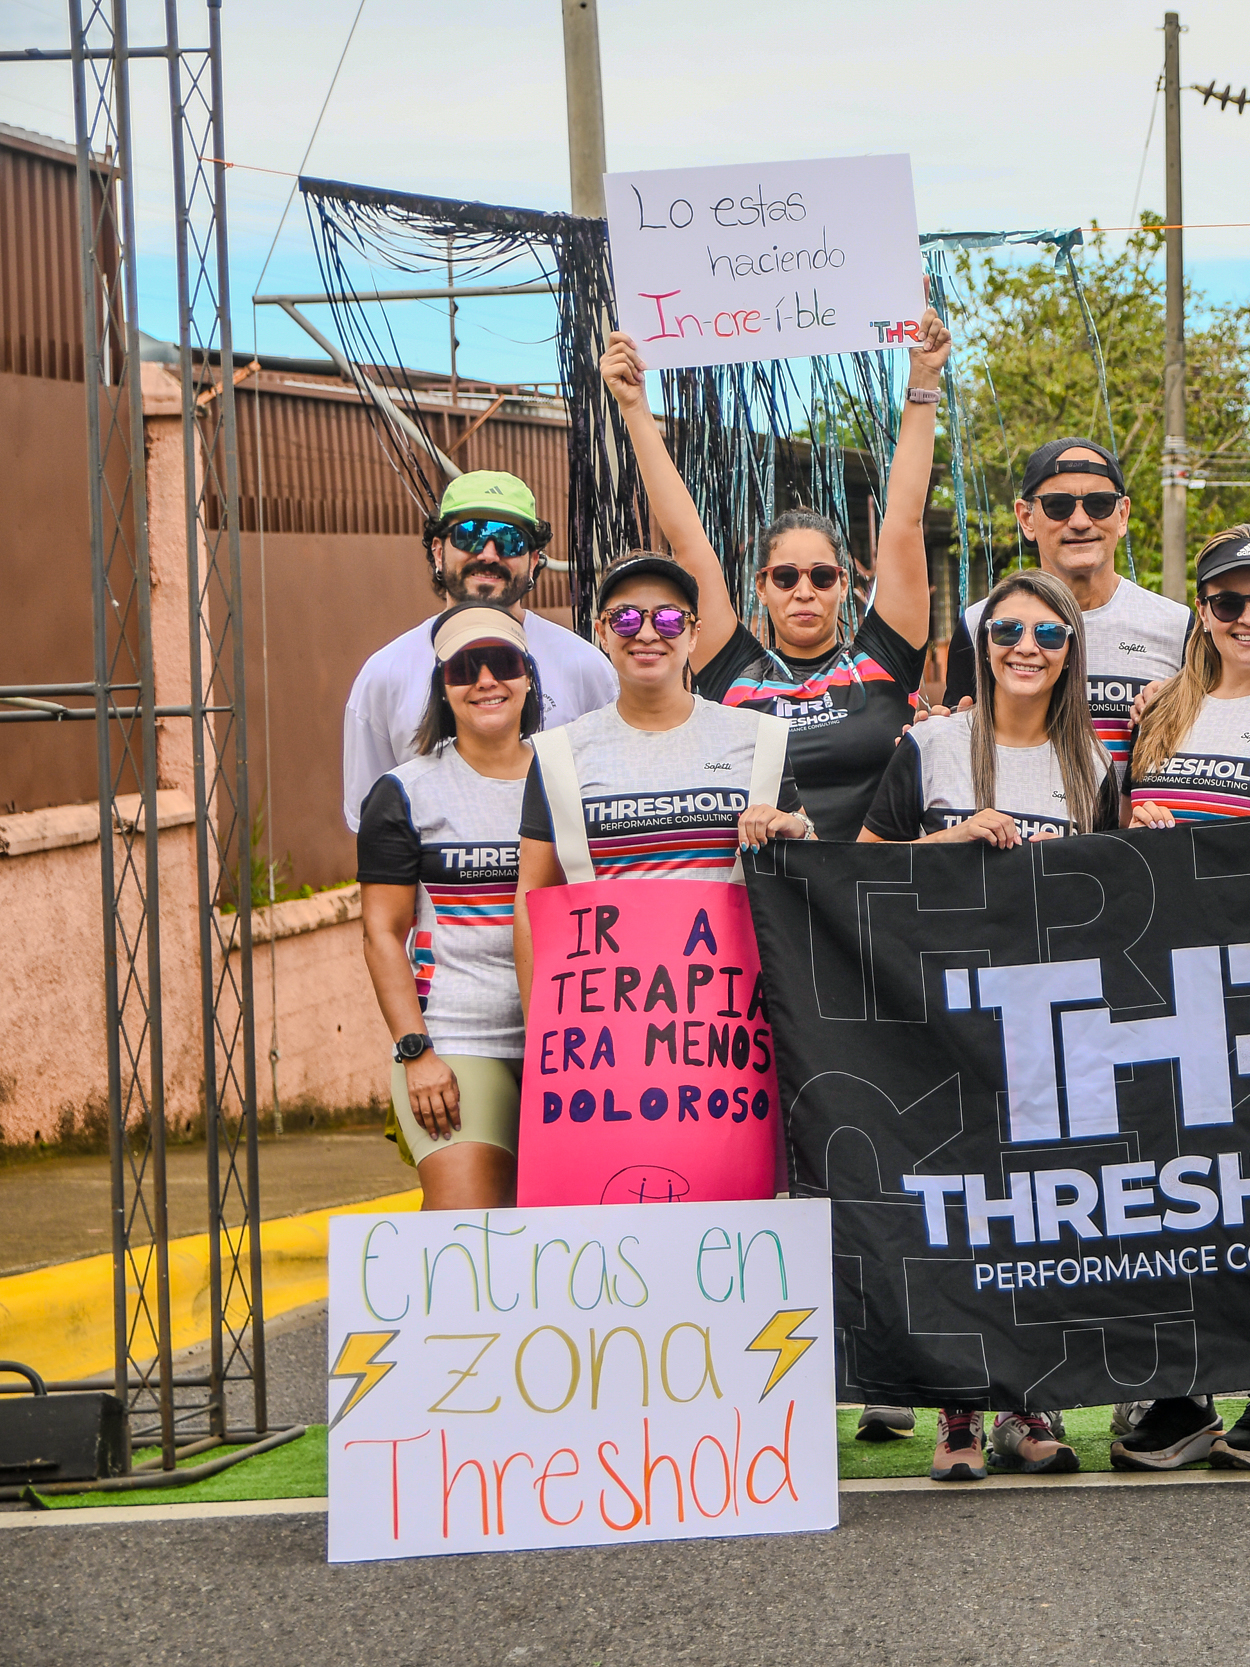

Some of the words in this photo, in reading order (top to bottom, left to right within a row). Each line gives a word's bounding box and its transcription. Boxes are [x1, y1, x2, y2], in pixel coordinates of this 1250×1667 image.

[631, 184, 694, 231] Lo
[709, 183, 806, 228] estas
[707, 225, 846, 281] haciendo
[1118, 641, 1148, 655] Safetti
[703, 762, 733, 773] Safetti
[1192, 778, 1248, 790] CONSULTING
[585, 792, 746, 823] THRESHOLD
[600, 816, 673, 831] PERFORMANCE
[674, 813, 733, 826] CONSULTING
[566, 905, 620, 959] IR
[683, 907, 718, 956] A
[551, 963, 770, 1024] TERAPIA
[540, 1026, 616, 1075] ERA
[644, 1019, 771, 1074] MENOS
[543, 1085, 770, 1124] DOLOROSO
[361, 1212, 649, 1322] Entras
[697, 1226, 788, 1304] en
[975, 1244, 1217, 1290] PERFORMANCE
[344, 1399, 799, 1541] Threshold
